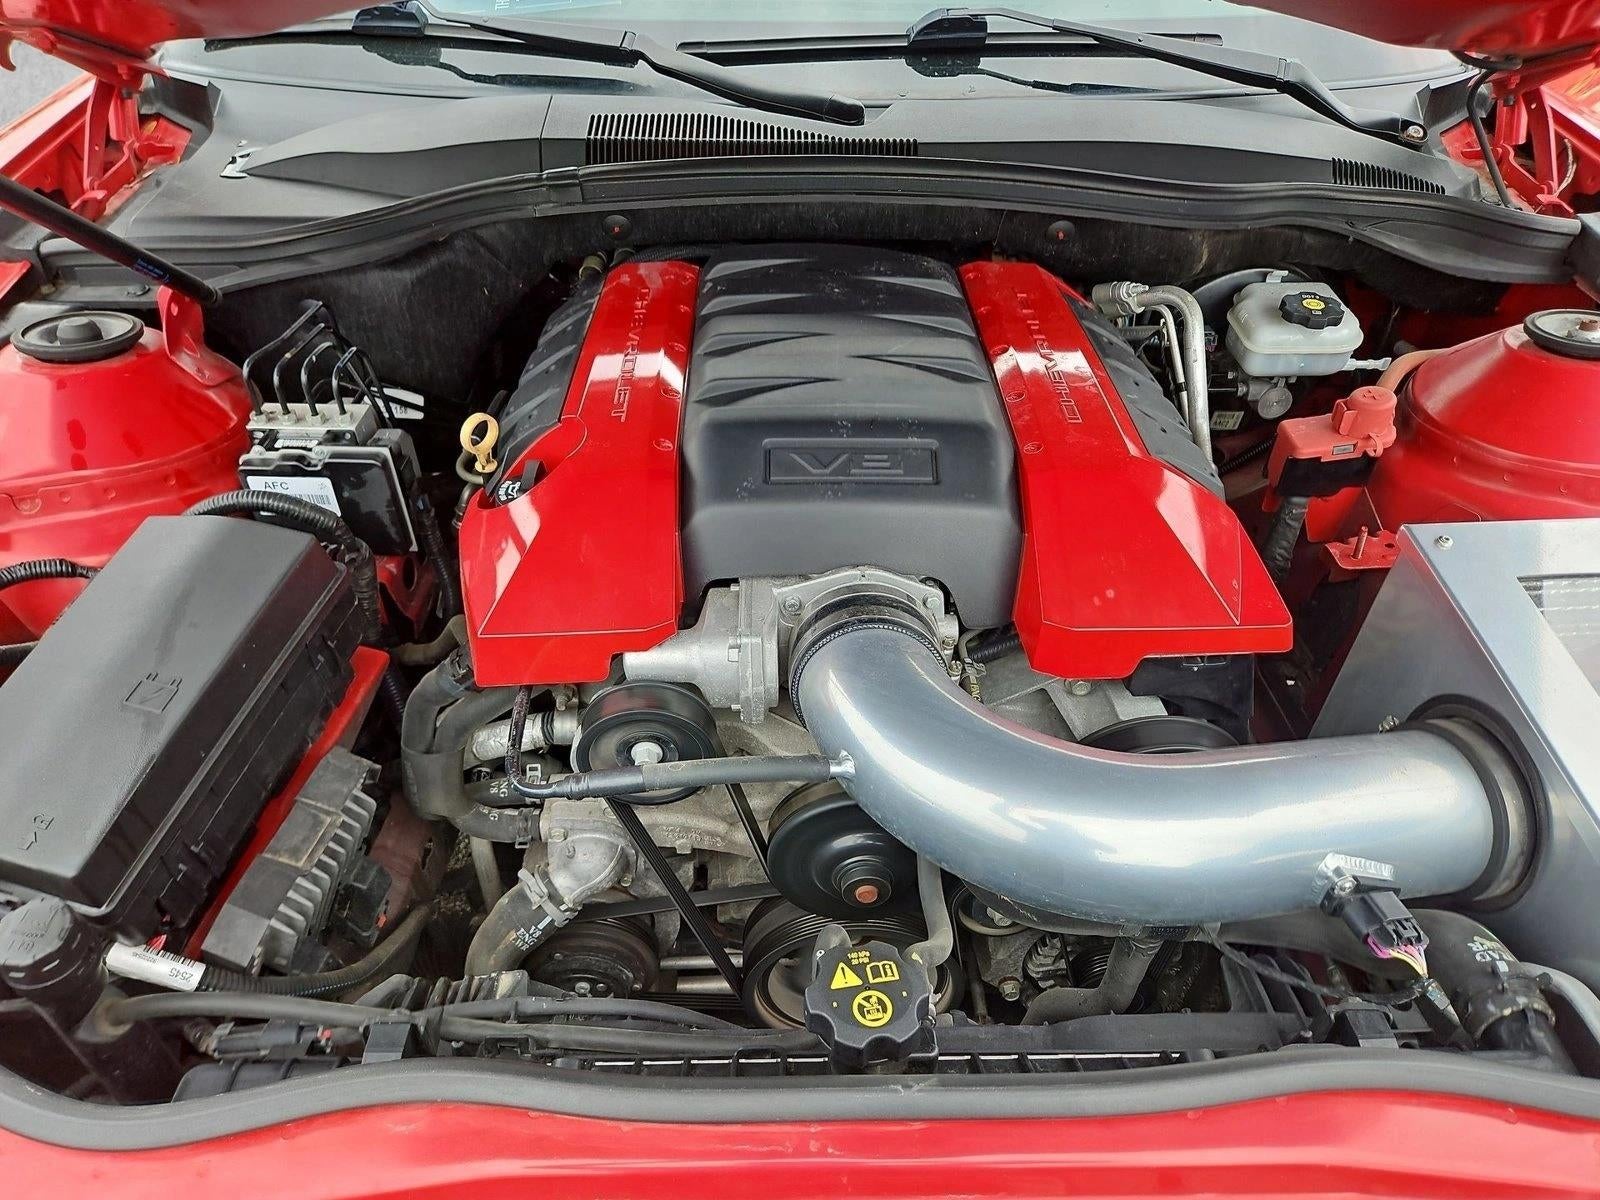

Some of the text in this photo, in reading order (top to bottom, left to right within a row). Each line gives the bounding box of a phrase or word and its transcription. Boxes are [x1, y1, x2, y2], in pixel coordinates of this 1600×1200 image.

[788, 451, 904, 476] V8
[264, 480, 290, 491] AFC
[516, 927, 537, 946] ENG
[168, 967, 194, 983] 2545
